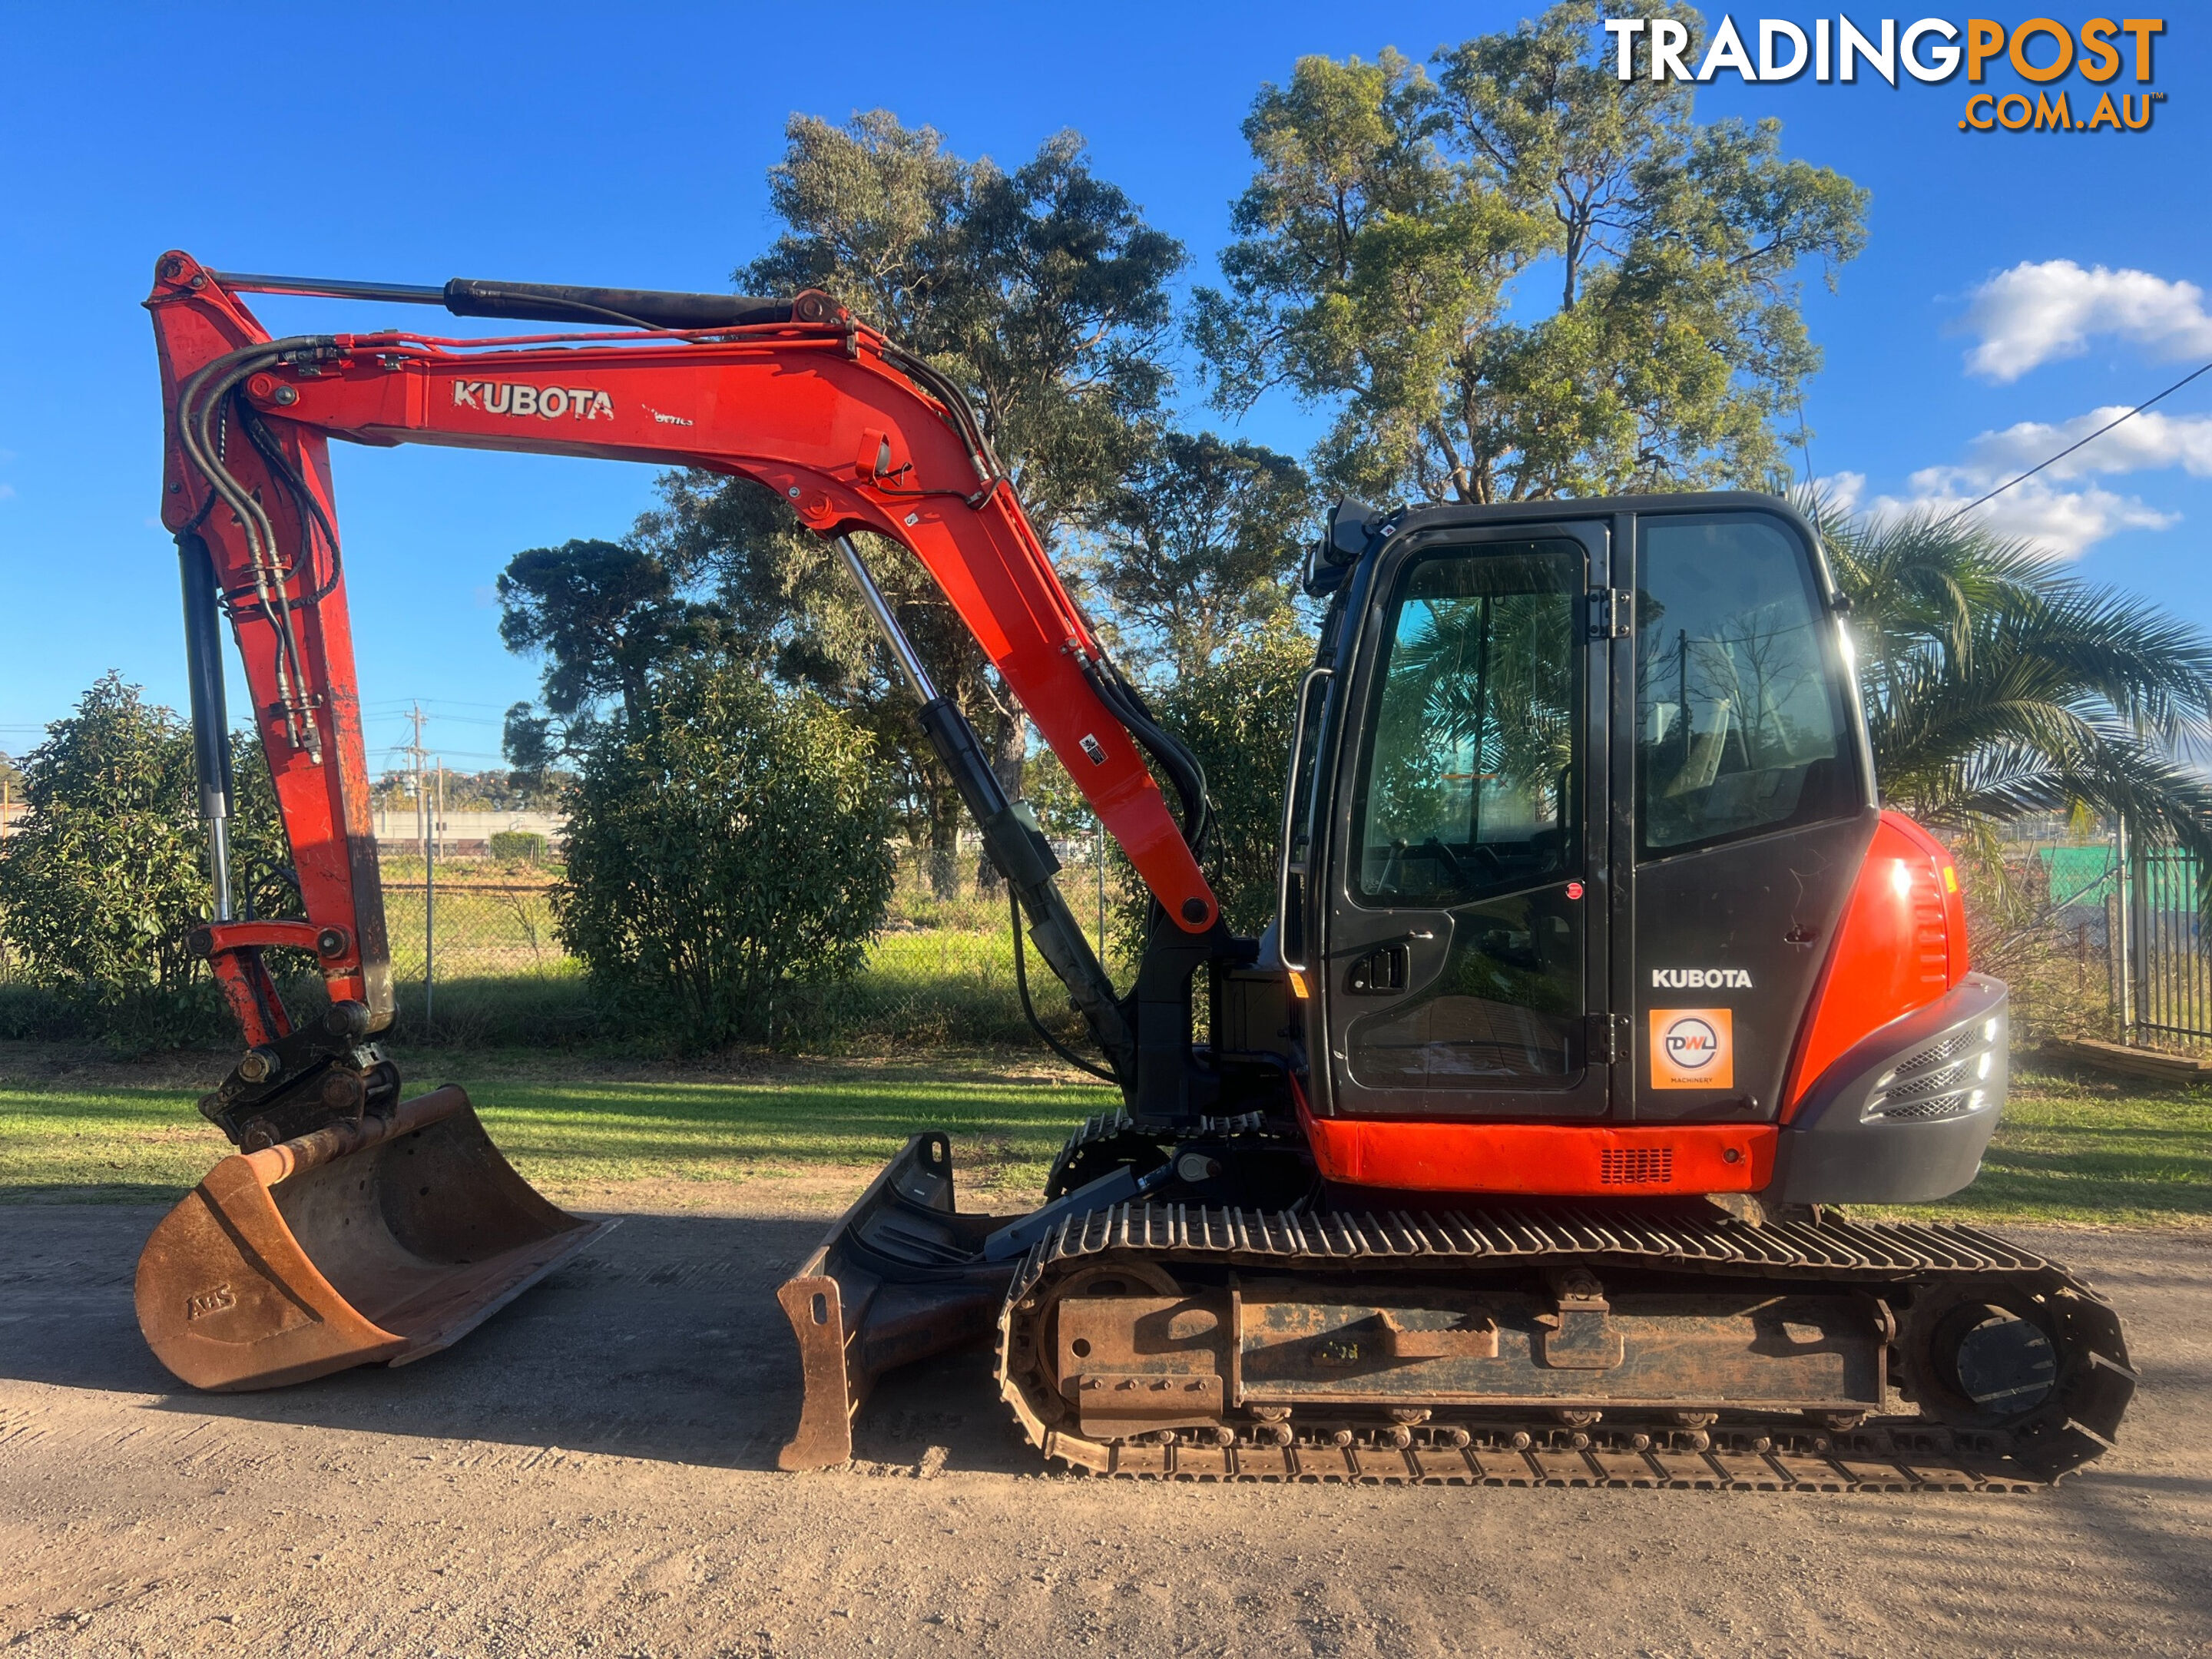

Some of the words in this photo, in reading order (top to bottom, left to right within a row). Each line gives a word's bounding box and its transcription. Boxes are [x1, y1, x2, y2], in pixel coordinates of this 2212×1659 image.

[453, 379, 615, 421] KUBOTA
[1651, 969, 1753, 989] KUBOTA
[1666, 1036, 1717, 1051] DWL
